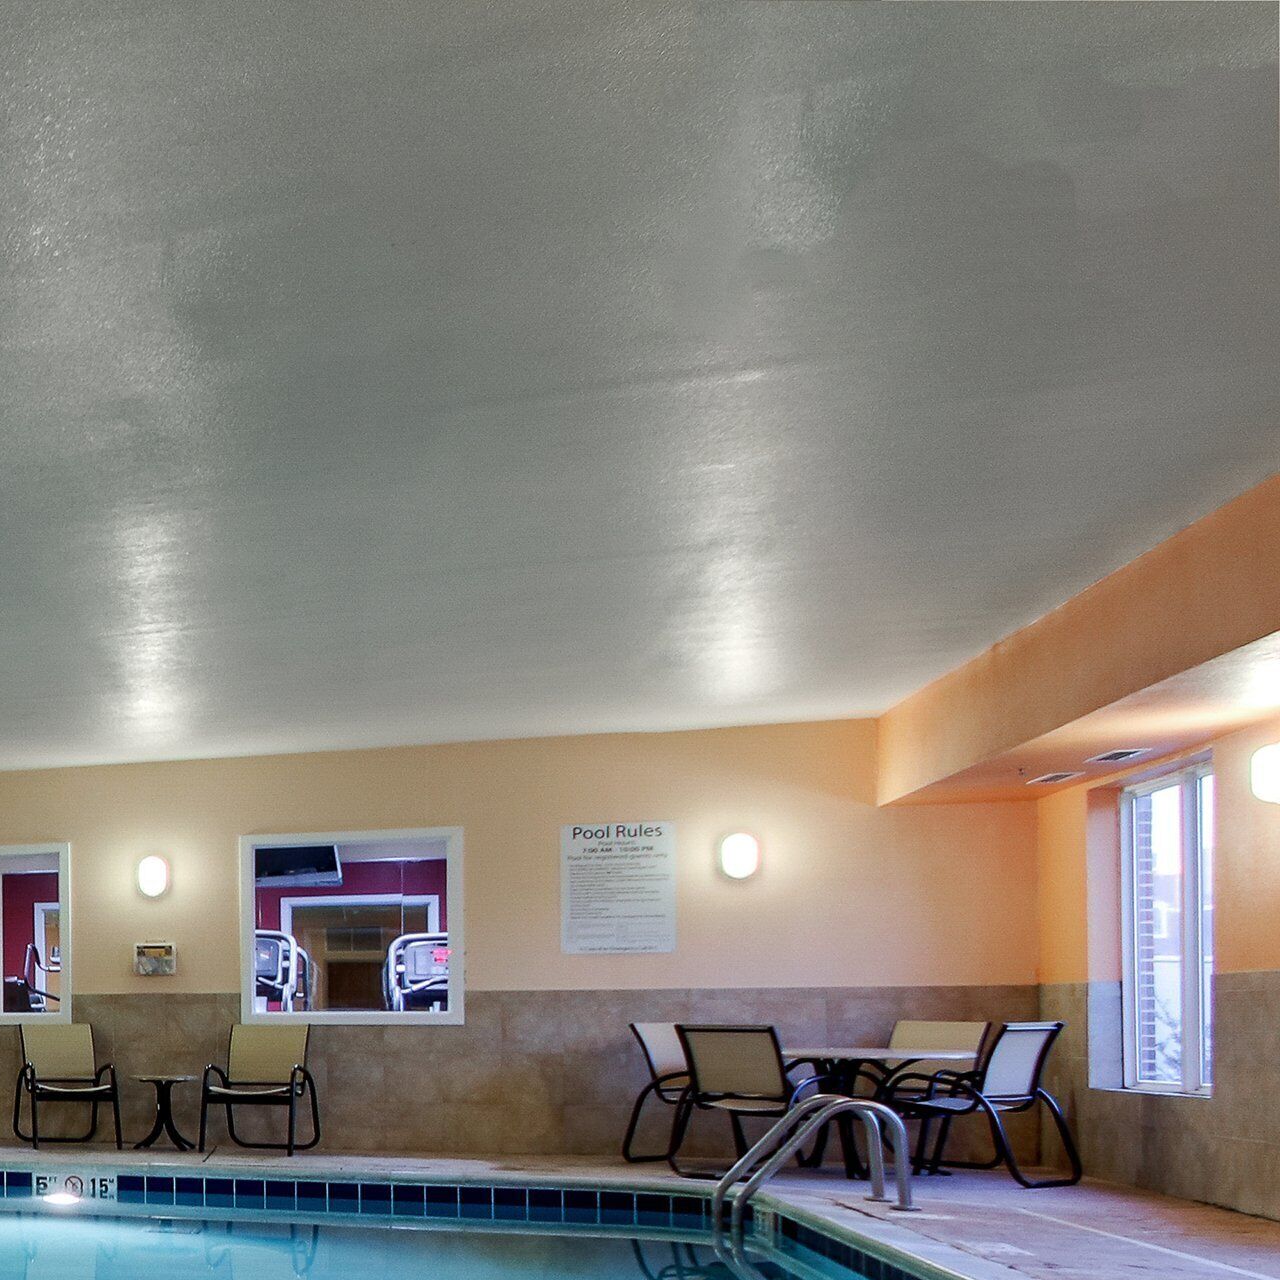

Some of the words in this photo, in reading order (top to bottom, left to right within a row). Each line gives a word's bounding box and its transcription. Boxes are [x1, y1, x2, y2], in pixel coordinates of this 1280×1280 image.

[572, 826, 610, 840] Pool
[616, 824, 662, 838] Rules
[35, 1176, 48, 1192] 5
